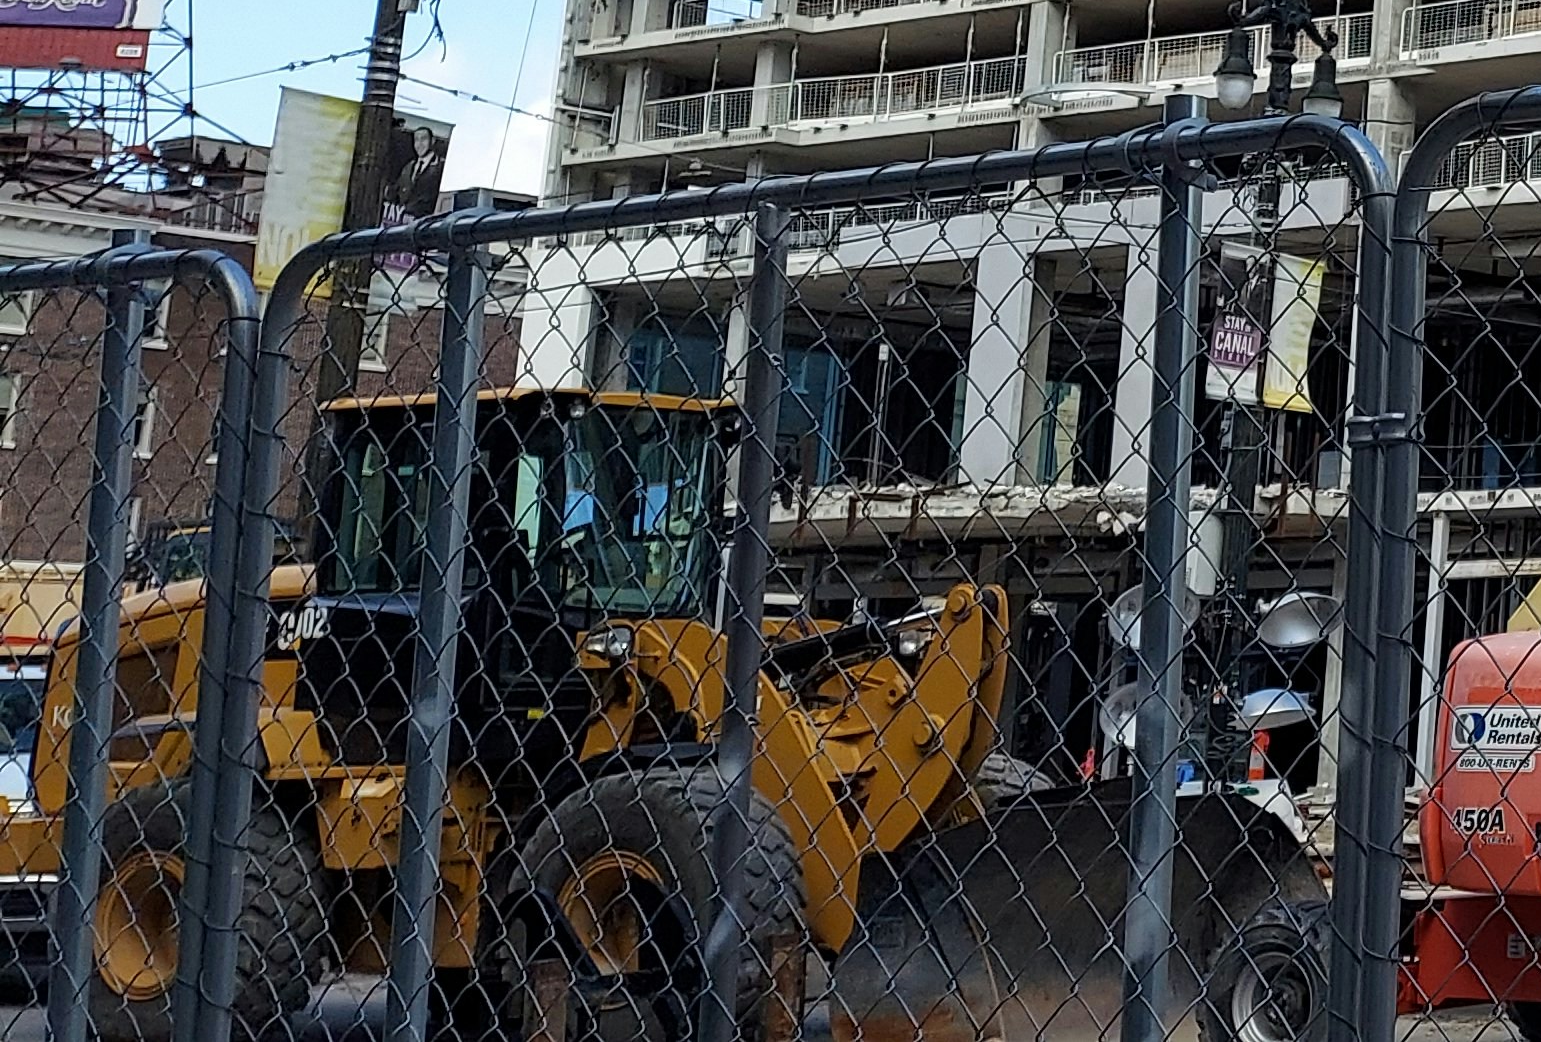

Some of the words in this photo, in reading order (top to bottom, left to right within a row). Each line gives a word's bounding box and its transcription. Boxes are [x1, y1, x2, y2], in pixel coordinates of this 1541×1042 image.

[383, 201, 406, 224] TAY
[1224, 315, 1246, 331] STAY
[1215, 331, 1255, 356] CANAL
[1490, 714, 1541, 729] United
[1452, 808, 1505, 834] 450A
